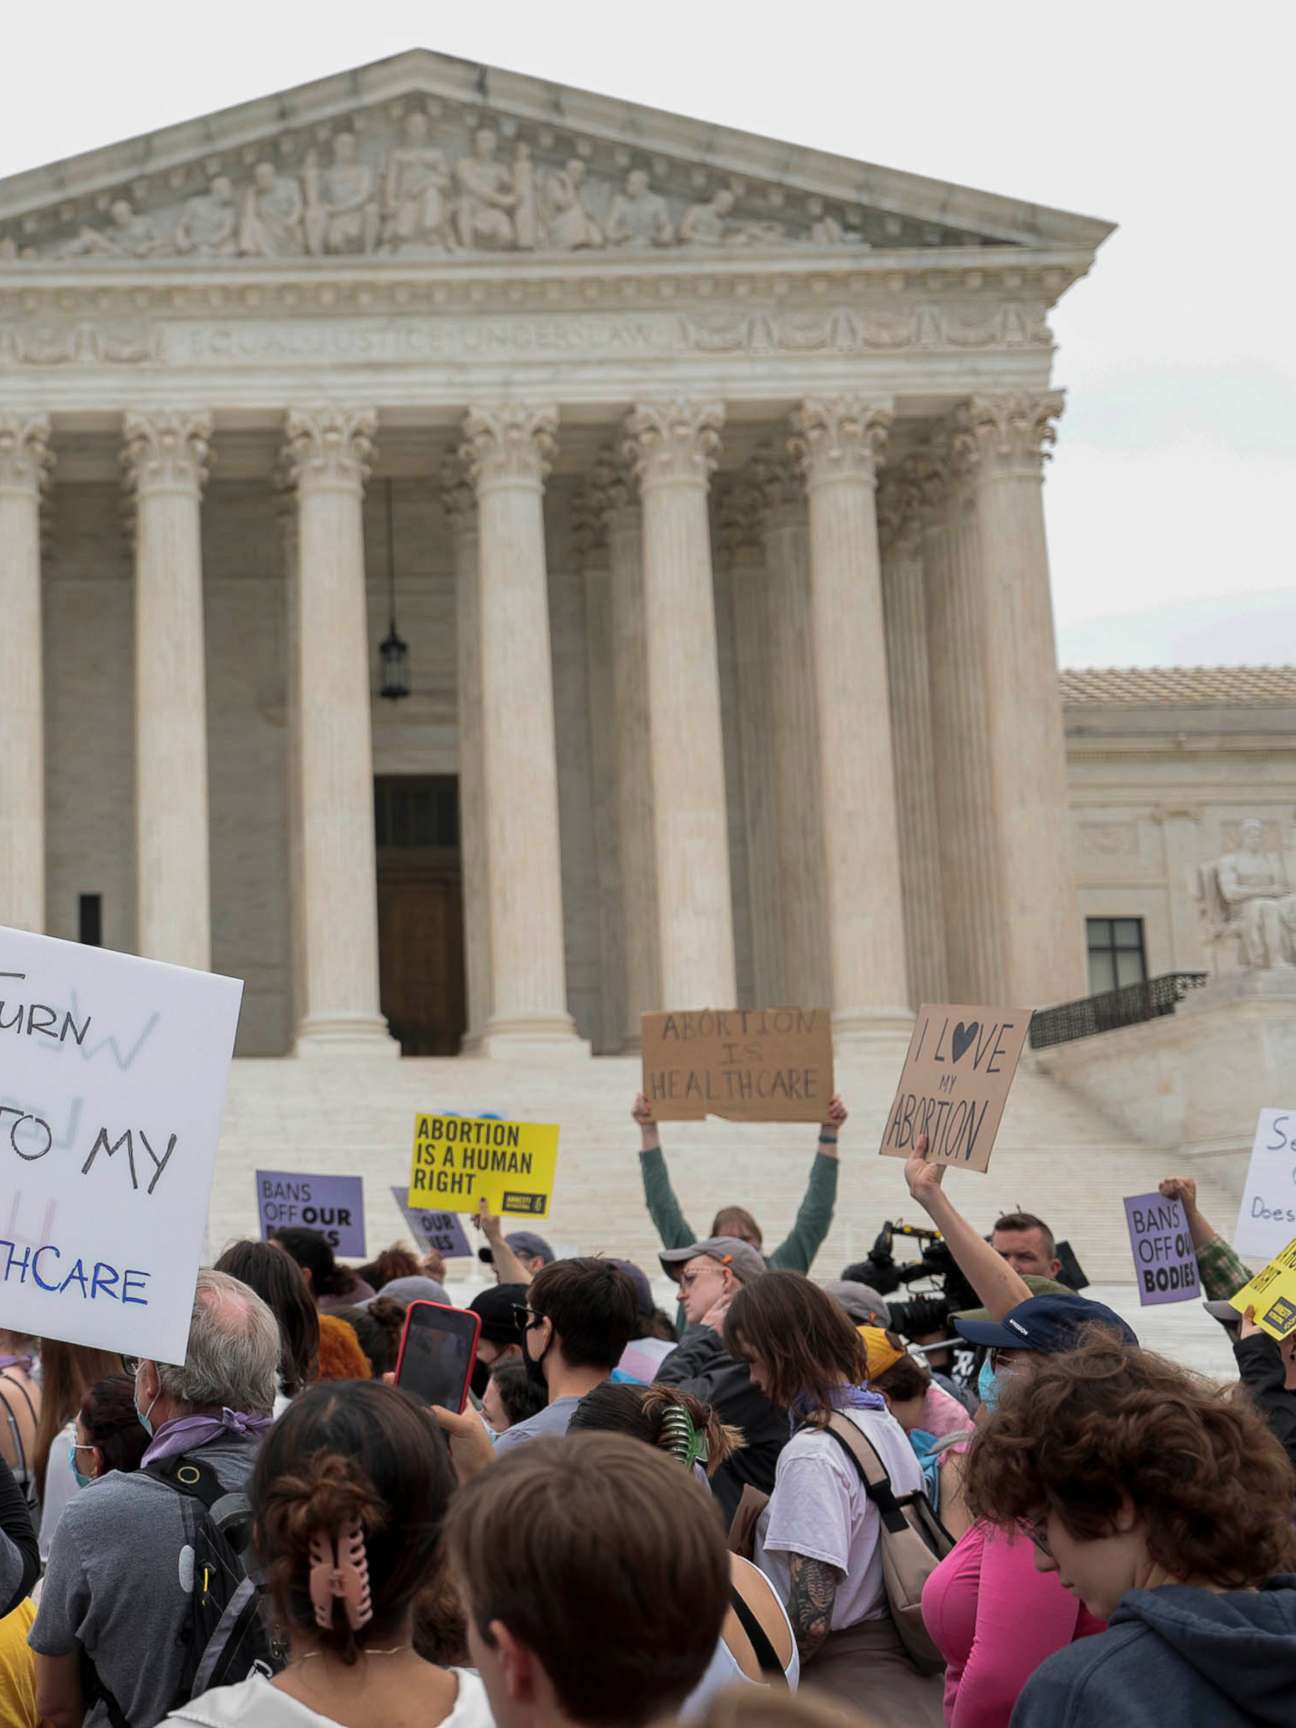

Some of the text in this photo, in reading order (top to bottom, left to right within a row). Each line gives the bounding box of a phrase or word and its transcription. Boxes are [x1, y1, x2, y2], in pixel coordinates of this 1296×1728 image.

[661, 1009, 817, 1041] ABORTION
[914, 1018, 929, 1062] I
[719, 1041, 765, 1065] IS
[651, 1069, 818, 1100] HEALTHCARE
[939, 1075, 958, 1095] MY
[417, 1117, 520, 1147] ABORTION
[886, 1093, 990, 1161] ABORTION
[81, 1128, 177, 1194] MY
[416, 1143, 533, 1174] IS A HUMAN
[263, 1180, 312, 1202] BANS
[413, 1167, 477, 1195] RIGHT
[264, 1201, 352, 1226] OFF OUR
[1132, 1203, 1181, 1234] BANS
[1138, 1232, 1192, 1263] OFF OU
[1142, 1261, 1196, 1294] BODIES
